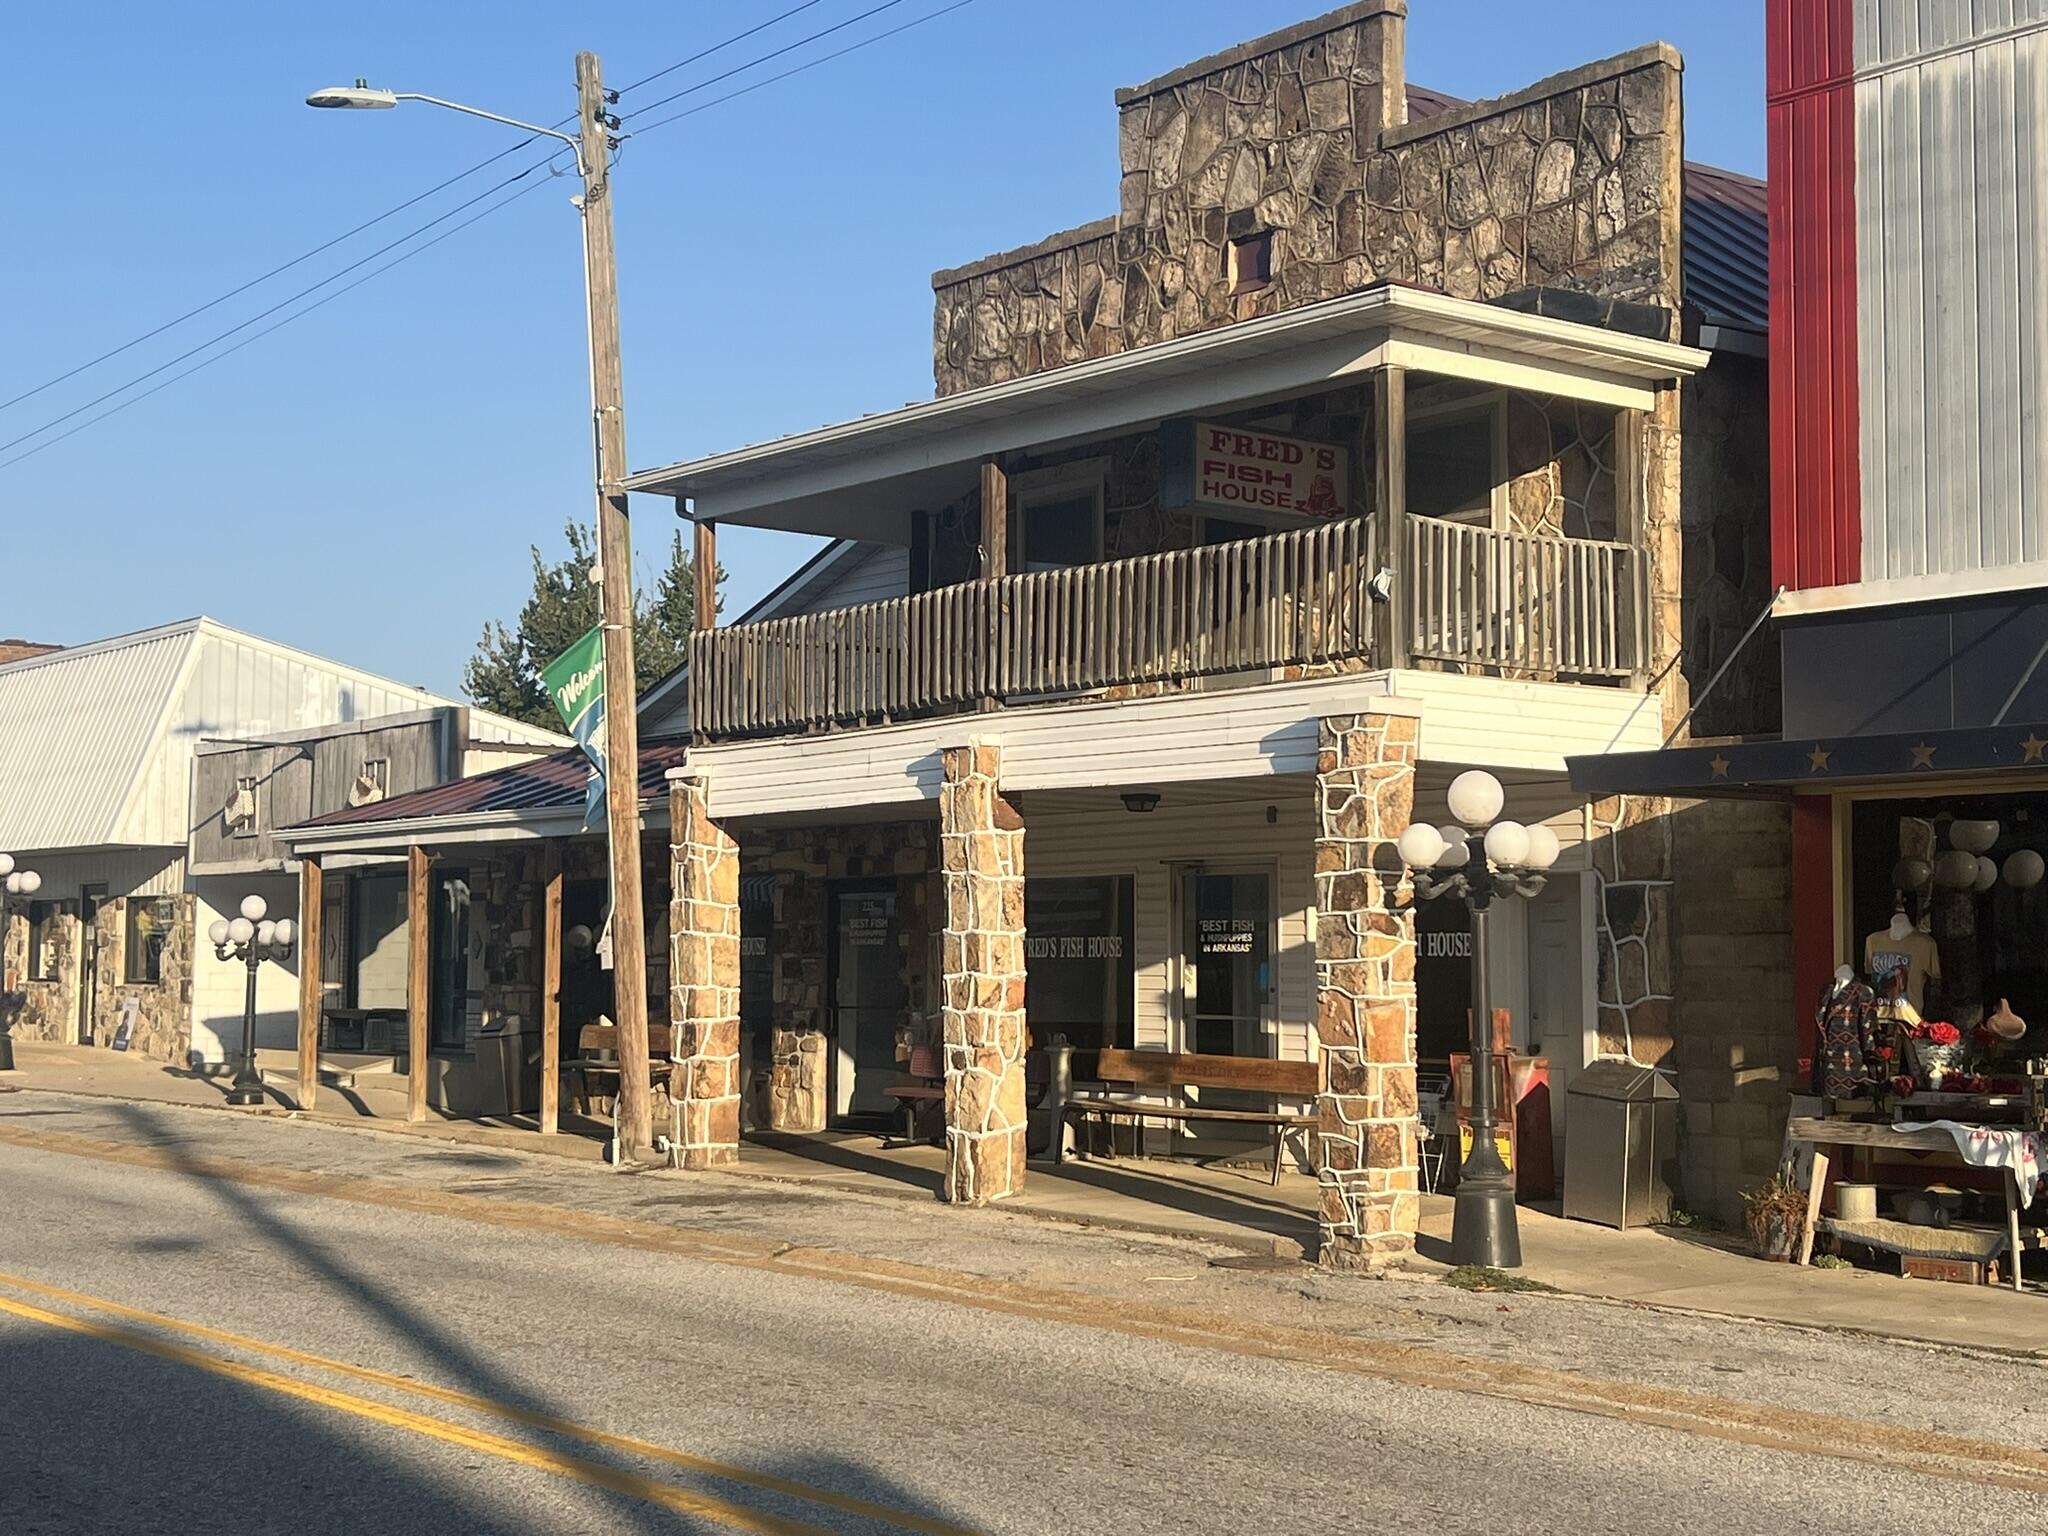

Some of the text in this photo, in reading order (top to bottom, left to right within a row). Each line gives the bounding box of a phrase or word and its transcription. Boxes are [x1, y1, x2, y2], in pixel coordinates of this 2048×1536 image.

[1208, 429, 1336, 471] FRED'S
[1203, 460, 1292, 489] FISH
[1203, 480, 1292, 510] HOUSE
[557, 661, 604, 713] Welcom
[1232, 920, 1255, 932] FISH
[1024, 936, 1123, 958] RED'S FISH HOUSE
[1427, 931, 1472, 957] HOUSE
